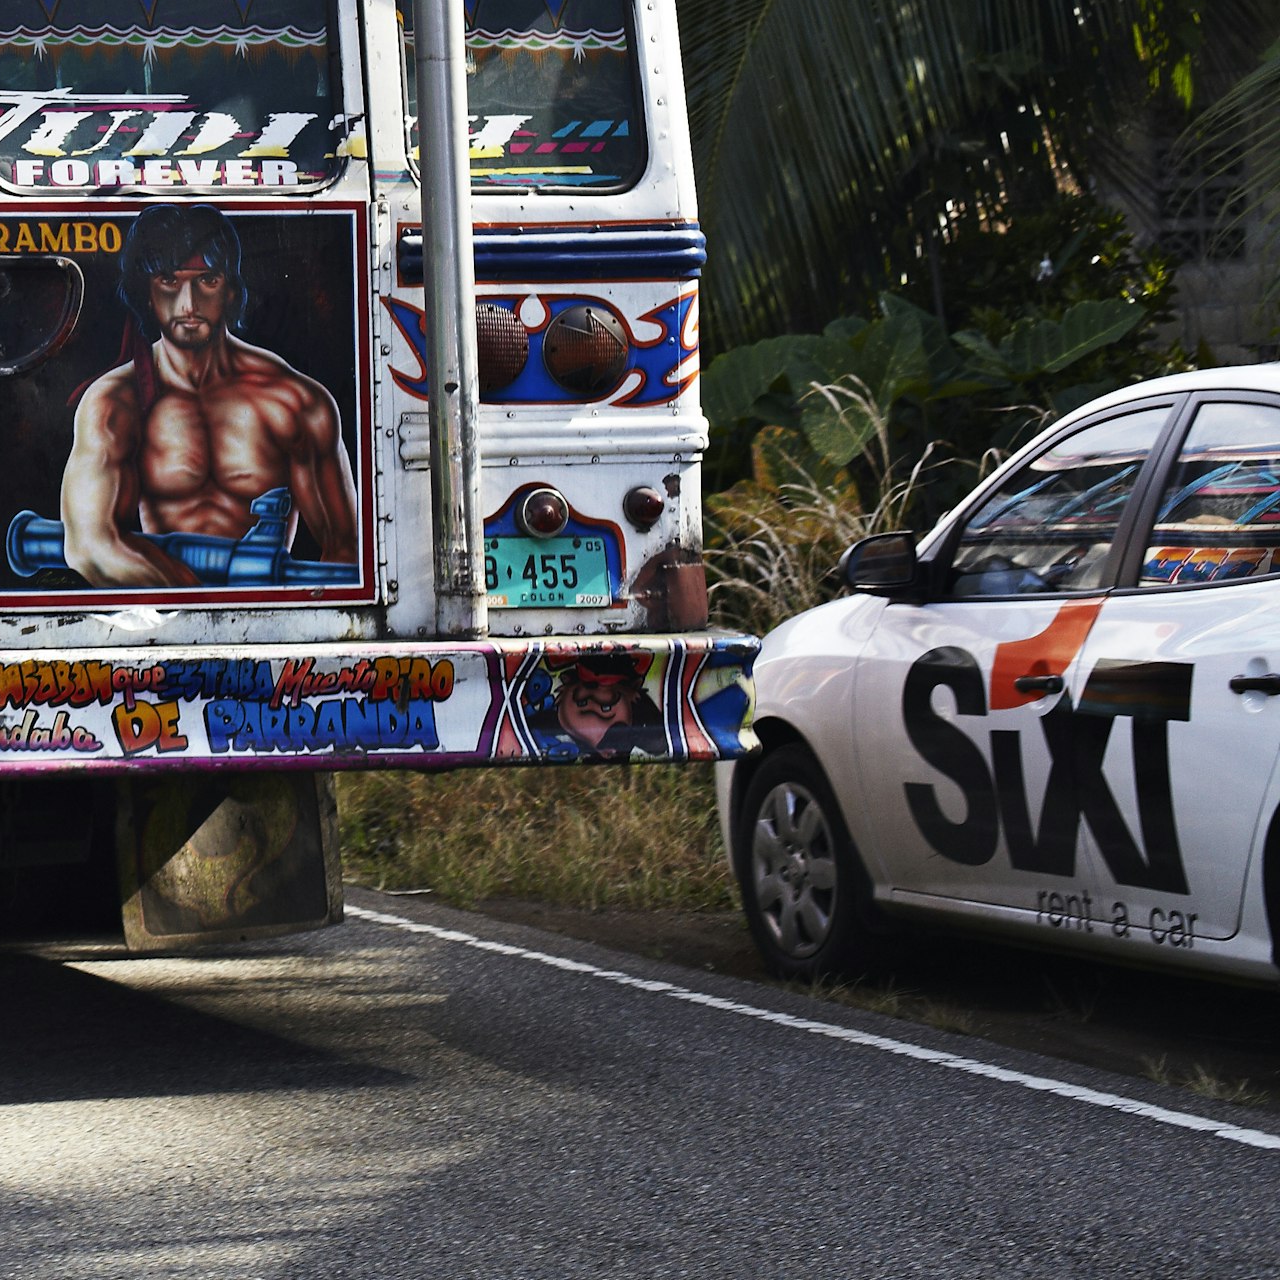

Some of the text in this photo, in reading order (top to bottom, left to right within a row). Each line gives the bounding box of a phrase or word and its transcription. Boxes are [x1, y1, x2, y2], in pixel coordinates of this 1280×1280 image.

[13, 159, 299, 186] FOREVER
[522, 553, 578, 589] 455
[521, 592, 565, 602] COLON
[580, 595, 604, 605] 2007
[112, 665, 169, 709] que
[158, 658, 275, 701] ESTABA
[112, 700, 188, 755] DE
[202, 698, 440, 753] PARRANDA
[1036, 889, 1199, 948] rent a car
